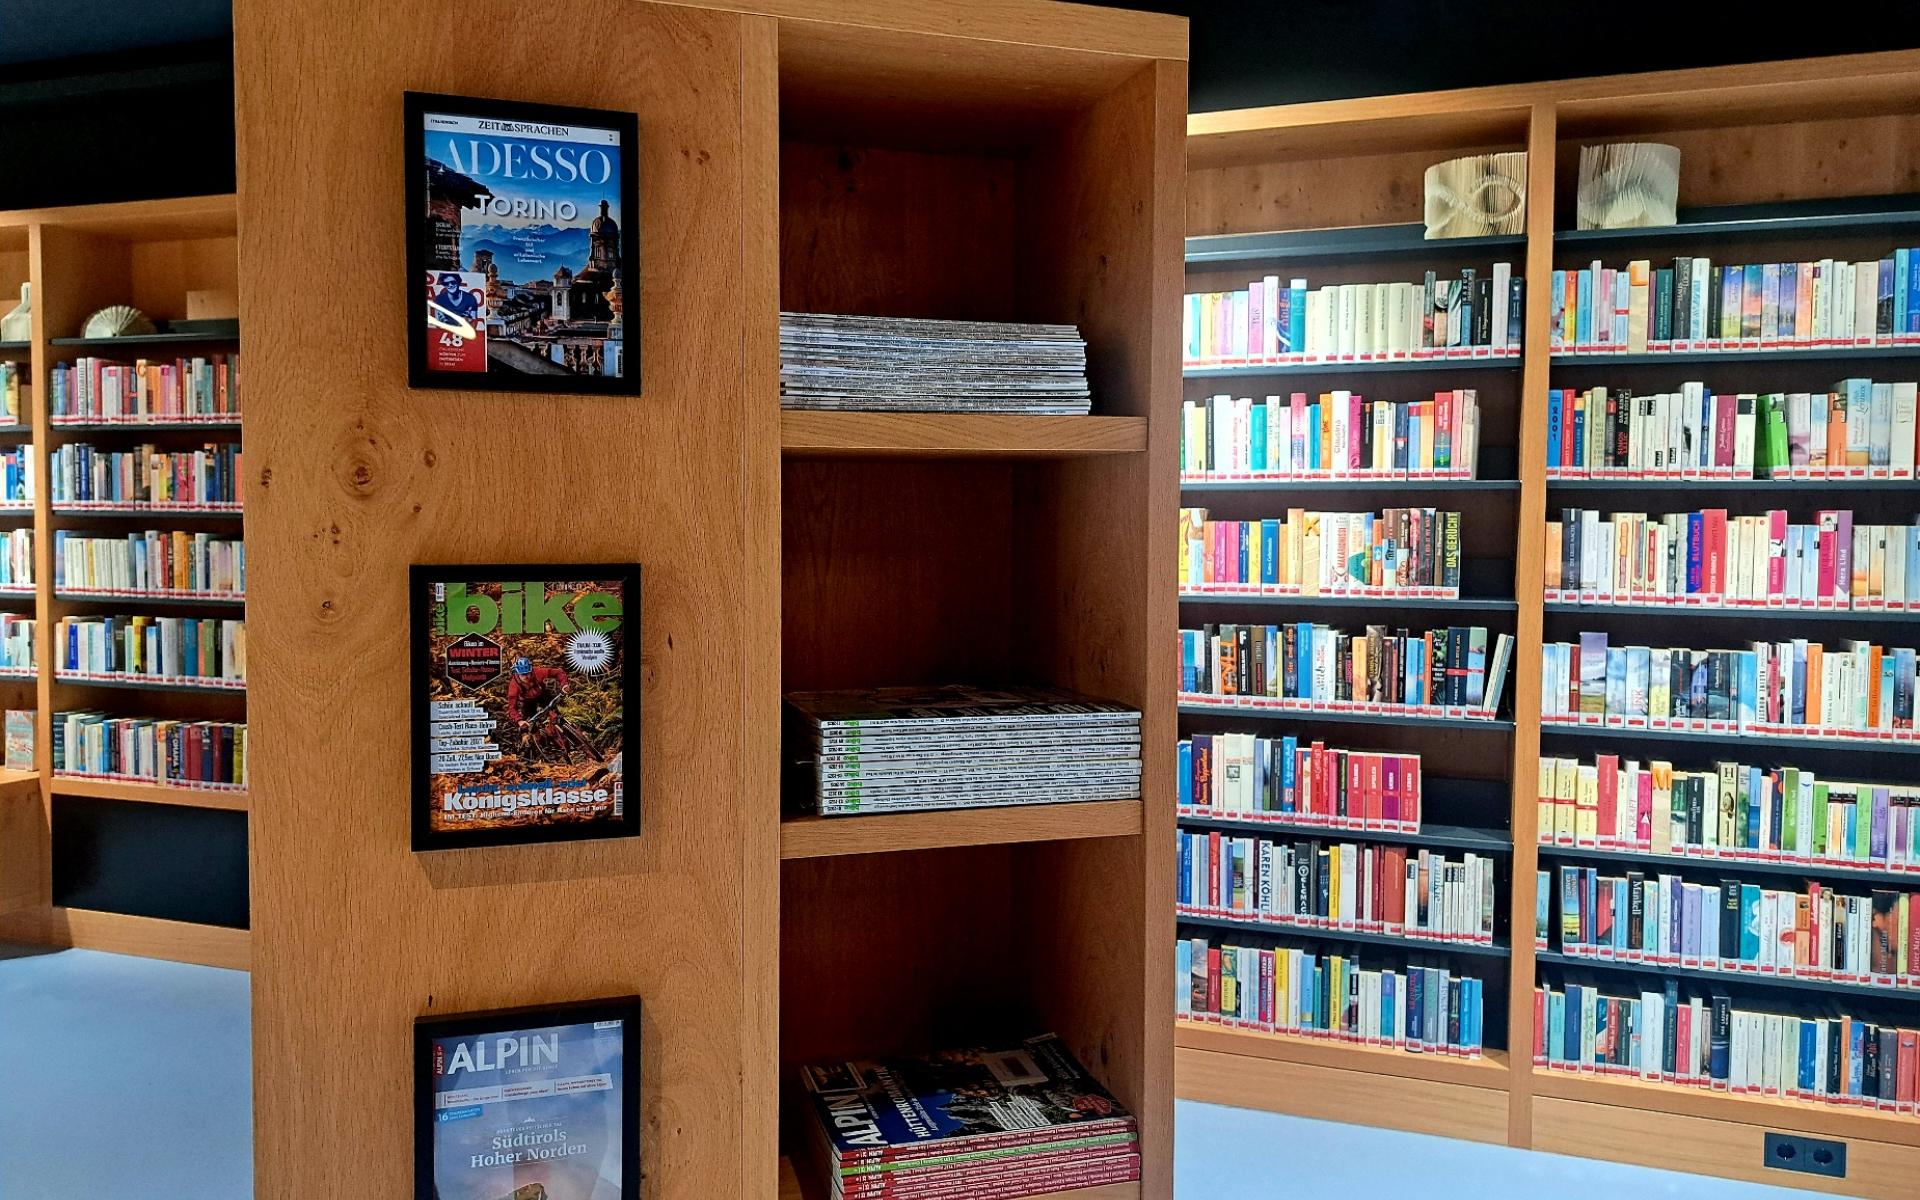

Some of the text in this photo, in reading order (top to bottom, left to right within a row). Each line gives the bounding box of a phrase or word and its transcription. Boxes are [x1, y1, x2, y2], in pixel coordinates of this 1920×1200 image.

[478, 121, 569, 136] ZEIT SPRACHEN
[450, 138, 611, 184] ADESSO
[474, 194, 578, 222] TORINO
[1445, 512, 1458, 568] DAS GERÜCHT
[1692, 520, 1700, 562] BLUTBUCH
[447, 581, 624, 634] bike
[449, 647, 499, 658] WINTER
[1652, 768, 1672, 791] M
[1724, 768, 1734, 778] H
[444, 788, 608, 812] Königsklasse
[1262, 842, 1272, 912] KAREN KÖHL
[1632, 880, 1642, 914] Mankell
[448, 1033, 558, 1074] ALPIN
[438, 1110, 448, 1122] 16
[823, 1094, 888, 1146] ALPIN
[492, 1128, 568, 1150] Südtirols
[470, 1142, 588, 1168] Hoher Norden
